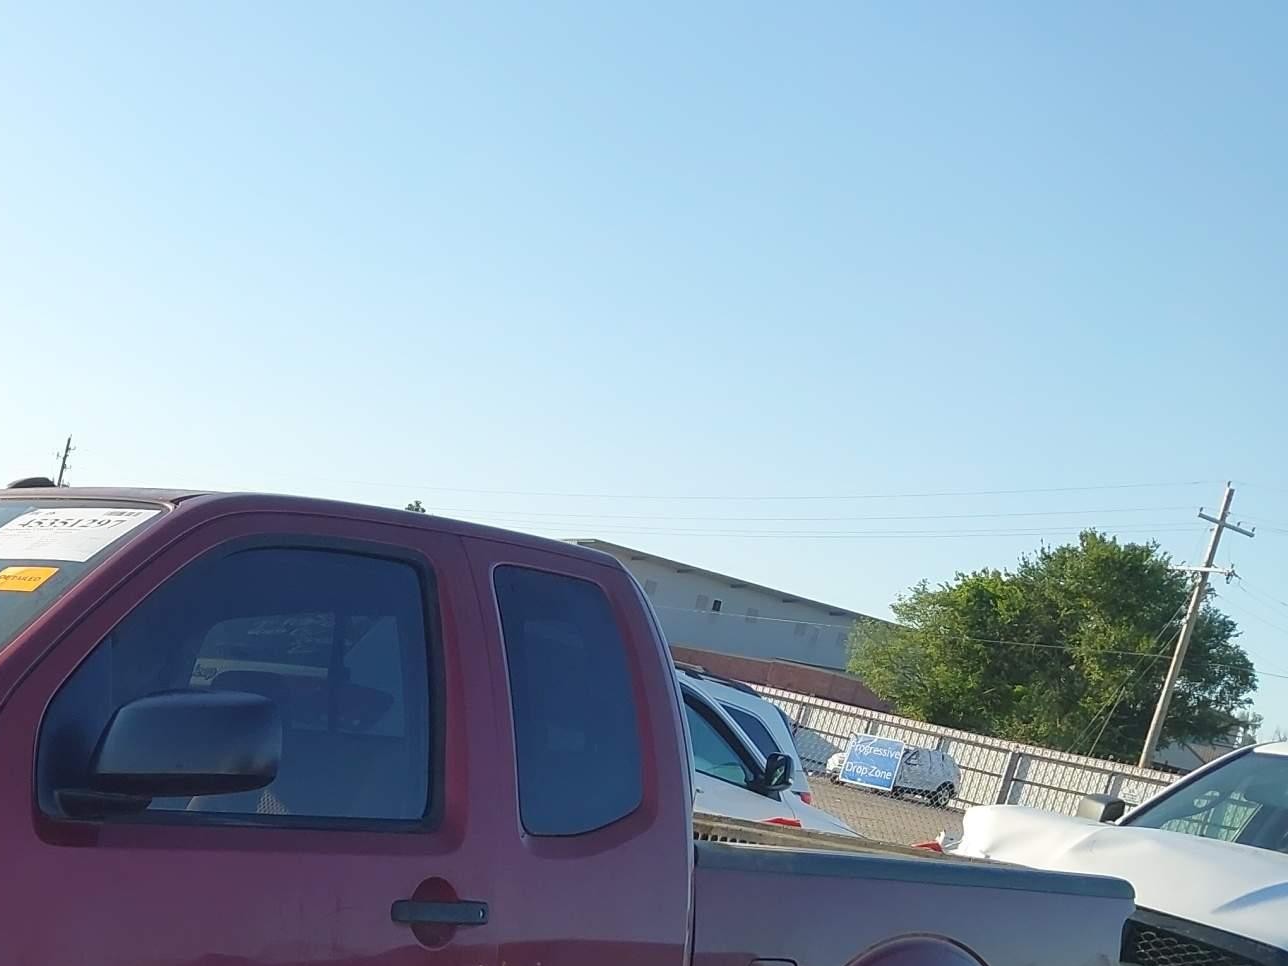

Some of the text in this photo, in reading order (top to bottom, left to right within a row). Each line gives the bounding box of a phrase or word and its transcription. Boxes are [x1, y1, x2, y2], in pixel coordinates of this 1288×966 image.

[18, 518, 127, 529] 45351297
[851, 741, 901, 759] Progressive
[845, 761, 892, 780] Drop Zone
